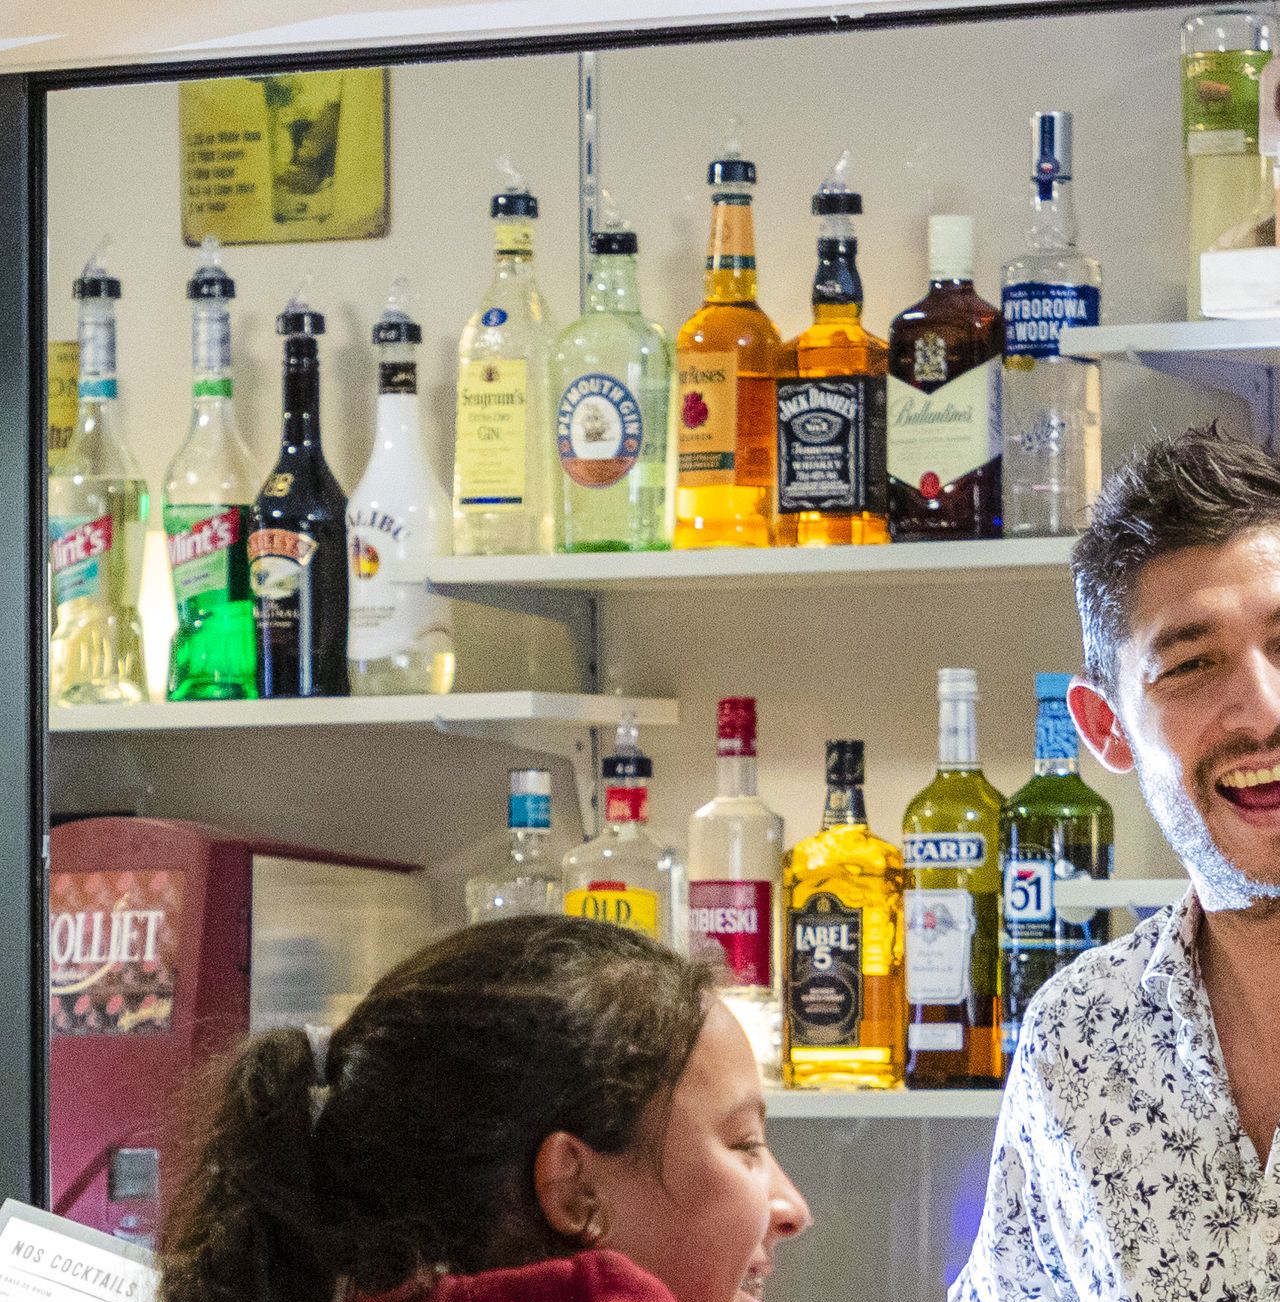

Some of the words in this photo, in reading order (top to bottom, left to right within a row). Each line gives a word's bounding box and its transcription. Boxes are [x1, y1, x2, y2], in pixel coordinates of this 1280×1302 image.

[1004, 298, 1087, 320] WYBOROWA
[463, 388, 525, 409] Seagram's
[558, 377, 625, 436] PLYMOUTH
[619, 400, 641, 435] GIN
[779, 392, 810, 421] JACK
[894, 399, 974, 426] Ballantine's
[477, 426, 500, 441] GIN
[52, 525, 106, 569] int's
[1010, 876, 1042, 911] 51
[581, 896, 632, 925] OLD
[689, 907, 758, 934] OBIESKI
[51, 909, 164, 964] OLLIET
[795, 924, 857, 951] LABEL
[813, 946, 833, 970] 5
[11, 1240, 45, 1263] NOS
[50, 1254, 138, 1297] COCKTAILS
[21, 1281, 31, 1290] DE
[31, 1286, 52, 1297] RHUM
